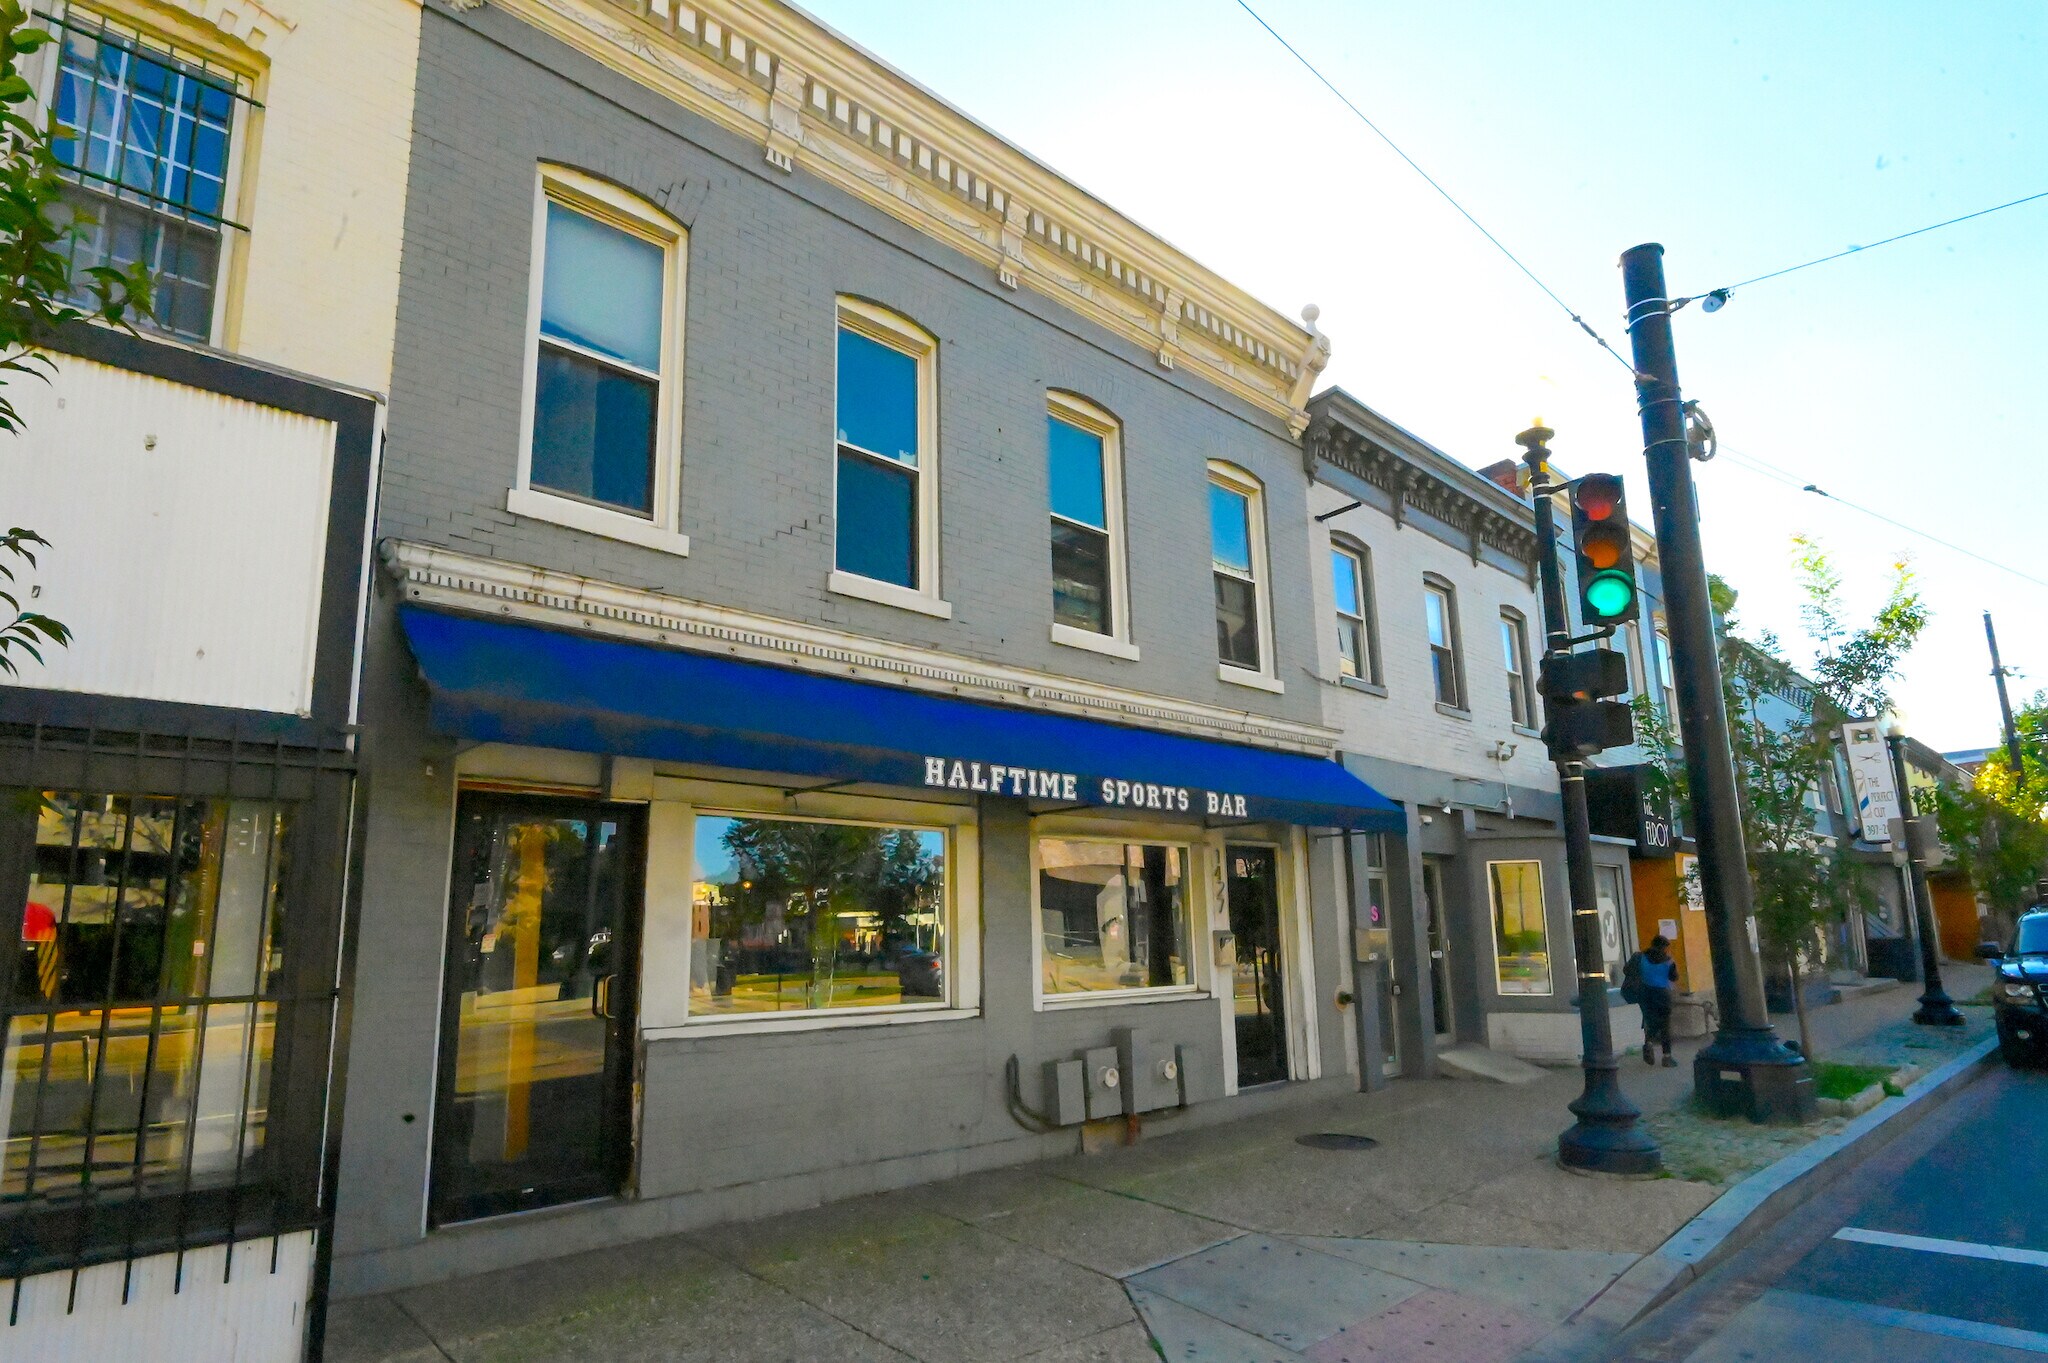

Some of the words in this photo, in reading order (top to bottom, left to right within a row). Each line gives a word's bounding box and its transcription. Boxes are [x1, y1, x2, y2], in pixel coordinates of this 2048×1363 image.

[924, 756, 1078, 801] HALFTIME
[1102, 777, 1190, 812] SPORTS
[1207, 790, 1248, 818] BAR
[1867, 776, 1880, 788] THE
[1870, 790, 1894, 802] PERFECT
[1873, 806, 1886, 818] CUT
[1866, 823, 1889, 836] 397-2
